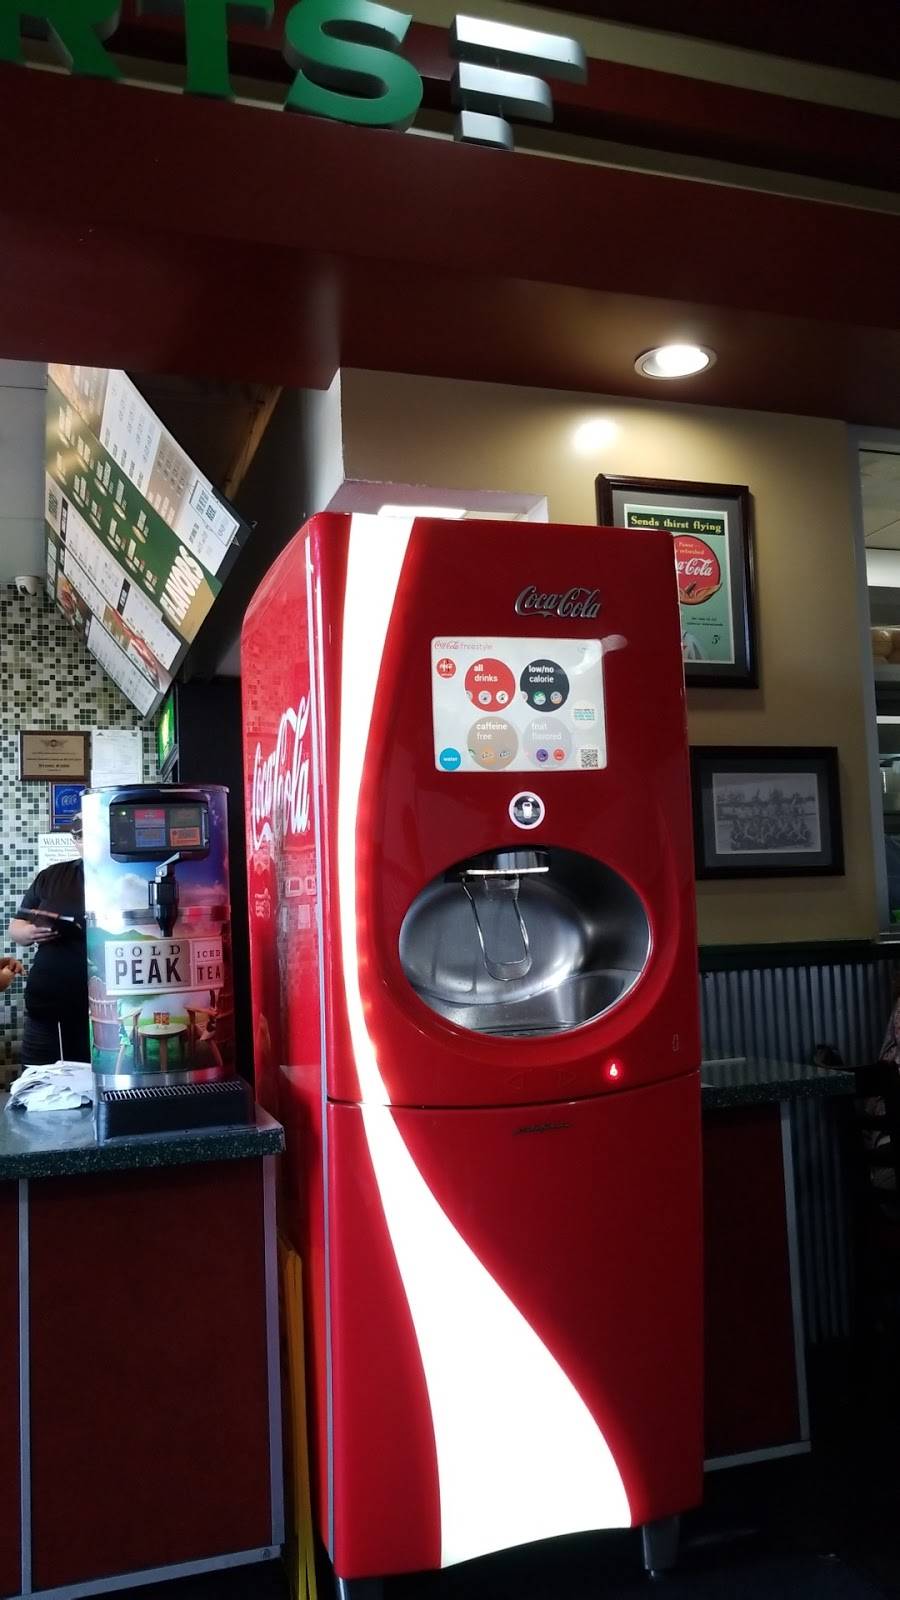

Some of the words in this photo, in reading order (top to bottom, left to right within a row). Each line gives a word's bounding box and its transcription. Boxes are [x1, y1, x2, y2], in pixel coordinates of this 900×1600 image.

[630, 515, 660, 527] Sends
[663, 518, 690, 530] thirst
[693, 522, 722, 534] flying
[677, 557, 713, 576] a-Cola
[160, 545, 204, 626] FLAVORS
[514, 585, 601, 618] Coca-Cola
[473, 664, 484, 672] all
[528, 665, 554, 674] low/no
[474, 674, 498, 682] drinks
[529, 675, 554, 683] calorie
[476, 722, 507, 730] caffeine
[252, 692, 312, 851] Coca-Cola
[43, 837, 76, 846] WARNIN
[114, 944, 181, 958] GOLD
[196, 949, 221, 959] ICED
[115, 957, 182, 985] PEAK
[196, 965, 221, 982] TEA
